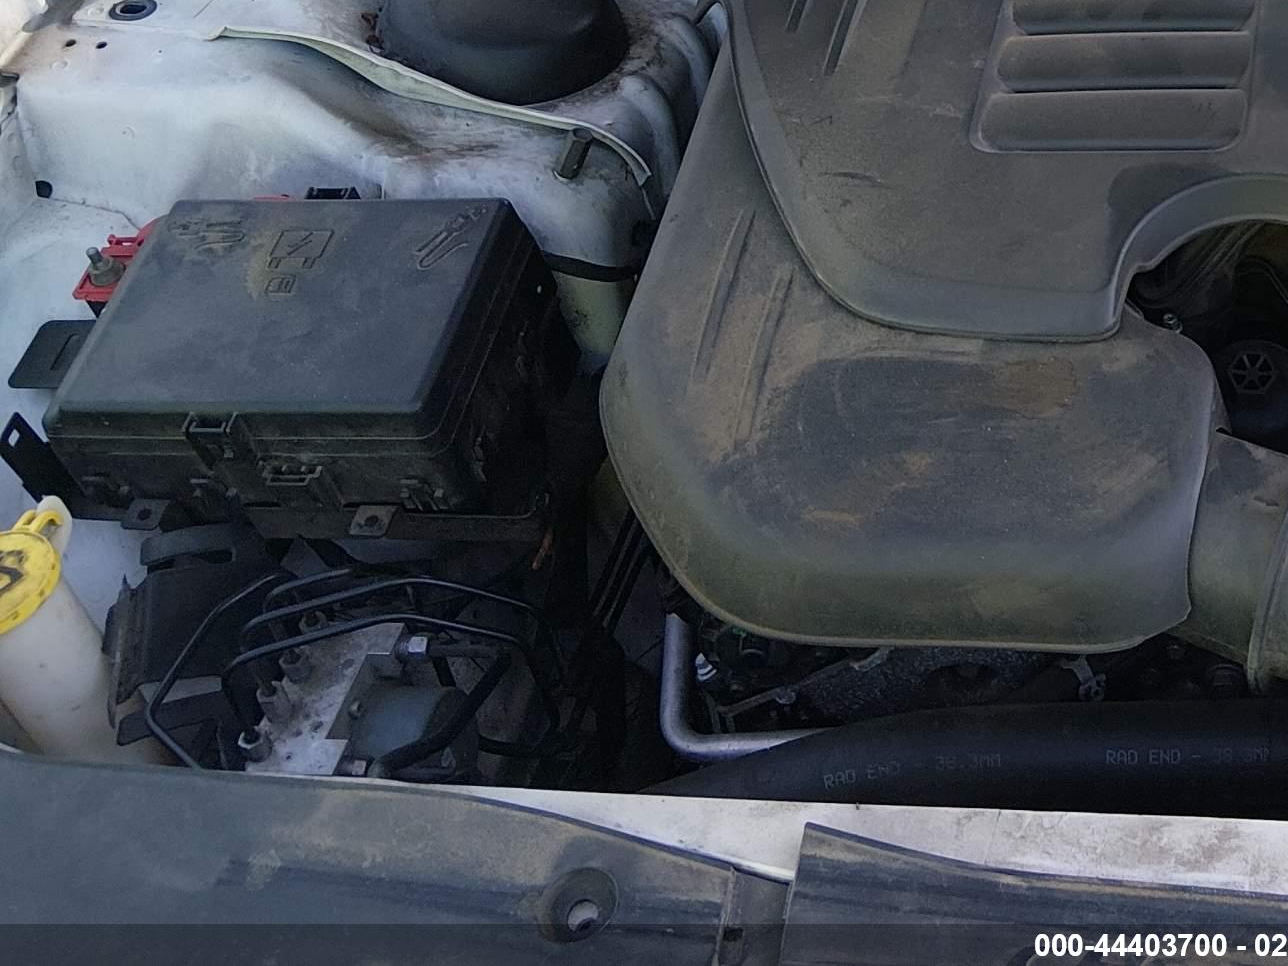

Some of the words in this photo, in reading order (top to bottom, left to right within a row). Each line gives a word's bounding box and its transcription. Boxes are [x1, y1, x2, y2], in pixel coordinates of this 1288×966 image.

[1106, 749, 1138, 764] RAD
[1149, 749, 1181, 764] END
[823, 769, 857, 791] RAD
